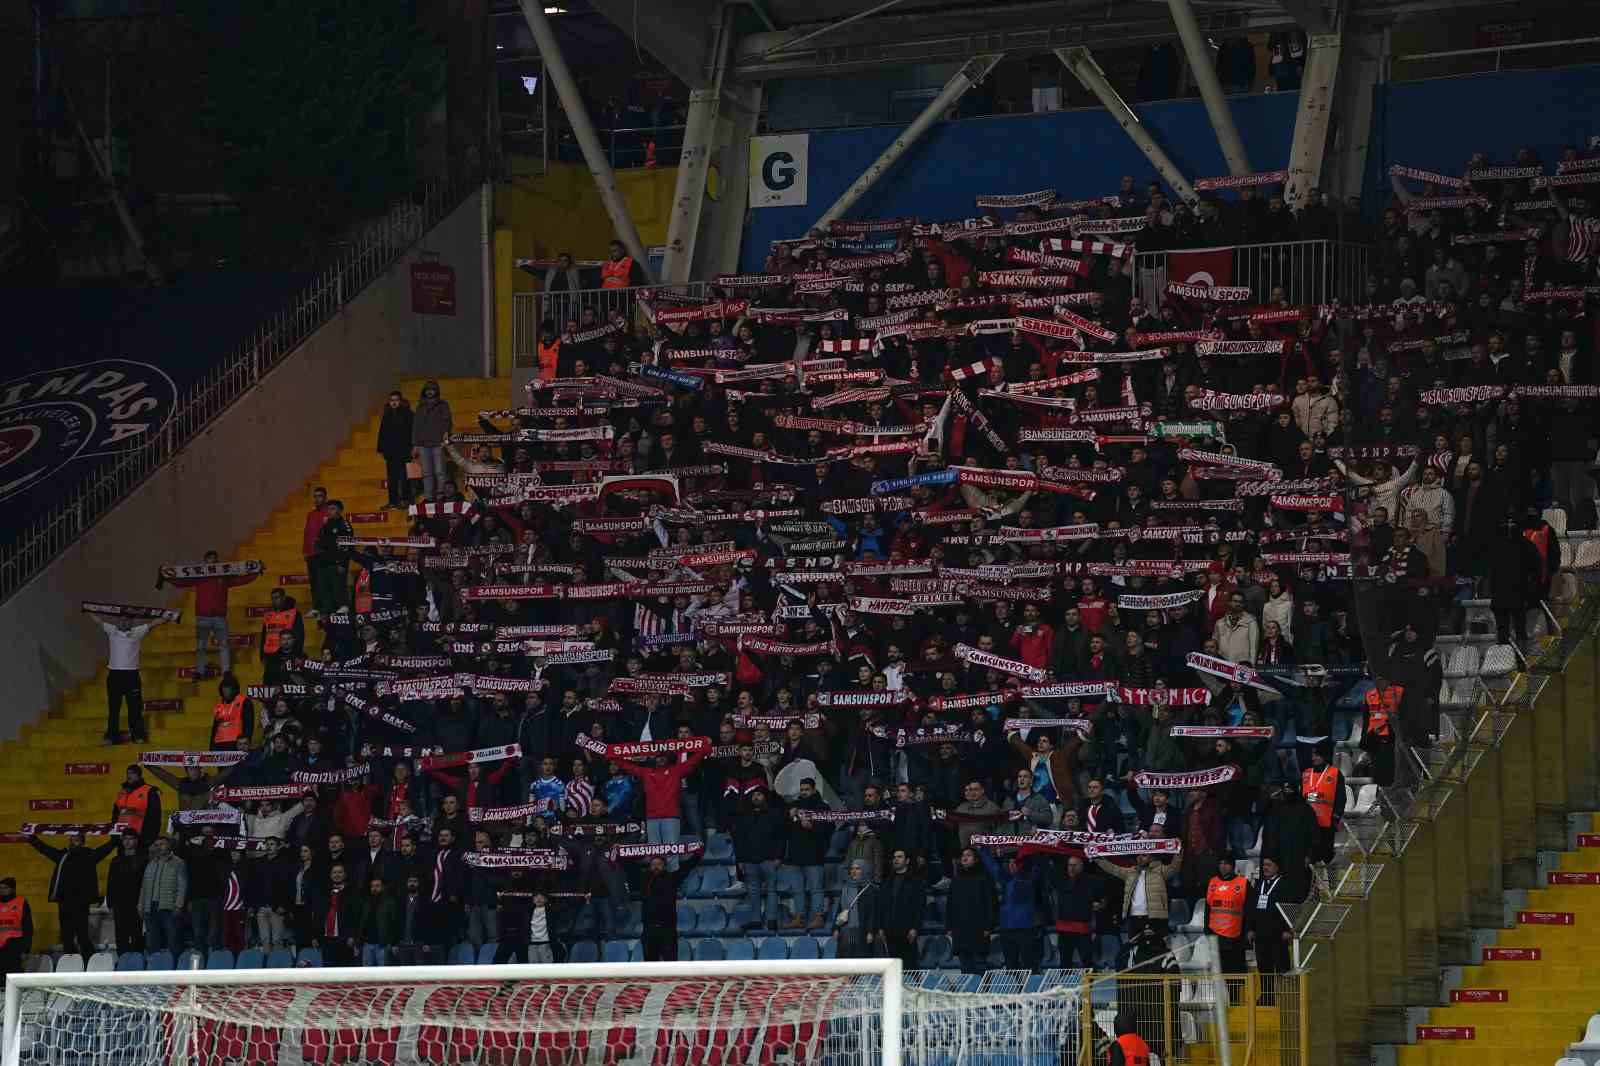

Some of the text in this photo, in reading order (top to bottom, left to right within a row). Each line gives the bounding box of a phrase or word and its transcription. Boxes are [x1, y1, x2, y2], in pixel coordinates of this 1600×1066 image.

[762, 152, 794, 191] G
[1218, 289, 1250, 301] SPOR
[1024, 429, 1090, 440] SAMSUNSPOR
[959, 471, 1036, 489] SAMSUNSPOR
[585, 520, 641, 531] SAMSUNSPOR
[477, 585, 544, 597] SAMSUNSPOR
[718, 625, 774, 635] SAMSUNSPOR
[390, 659, 450, 670] SAMSUNSPOR
[969, 652, 1031, 674] SAMSUNSPOR
[391, 679, 455, 695] SAMSUNSPOR
[476, 678, 531, 691] SAMSUNSPOR
[1033, 682, 1104, 698] SAMSUNSPOR
[832, 693, 892, 705] SAMSUNSPOR
[941, 694, 1005, 710] SAMSUNSPOR
[613, 740, 704, 756] SAMSUNSPOR
[228, 786, 299, 797] SAMSUNSPOR
[619, 846, 685, 858] SAMSUNSPOR
[1105, 843, 1156, 852] SAMSUNSPOR
[482, 856, 549, 866] SAMSUNSPOR
